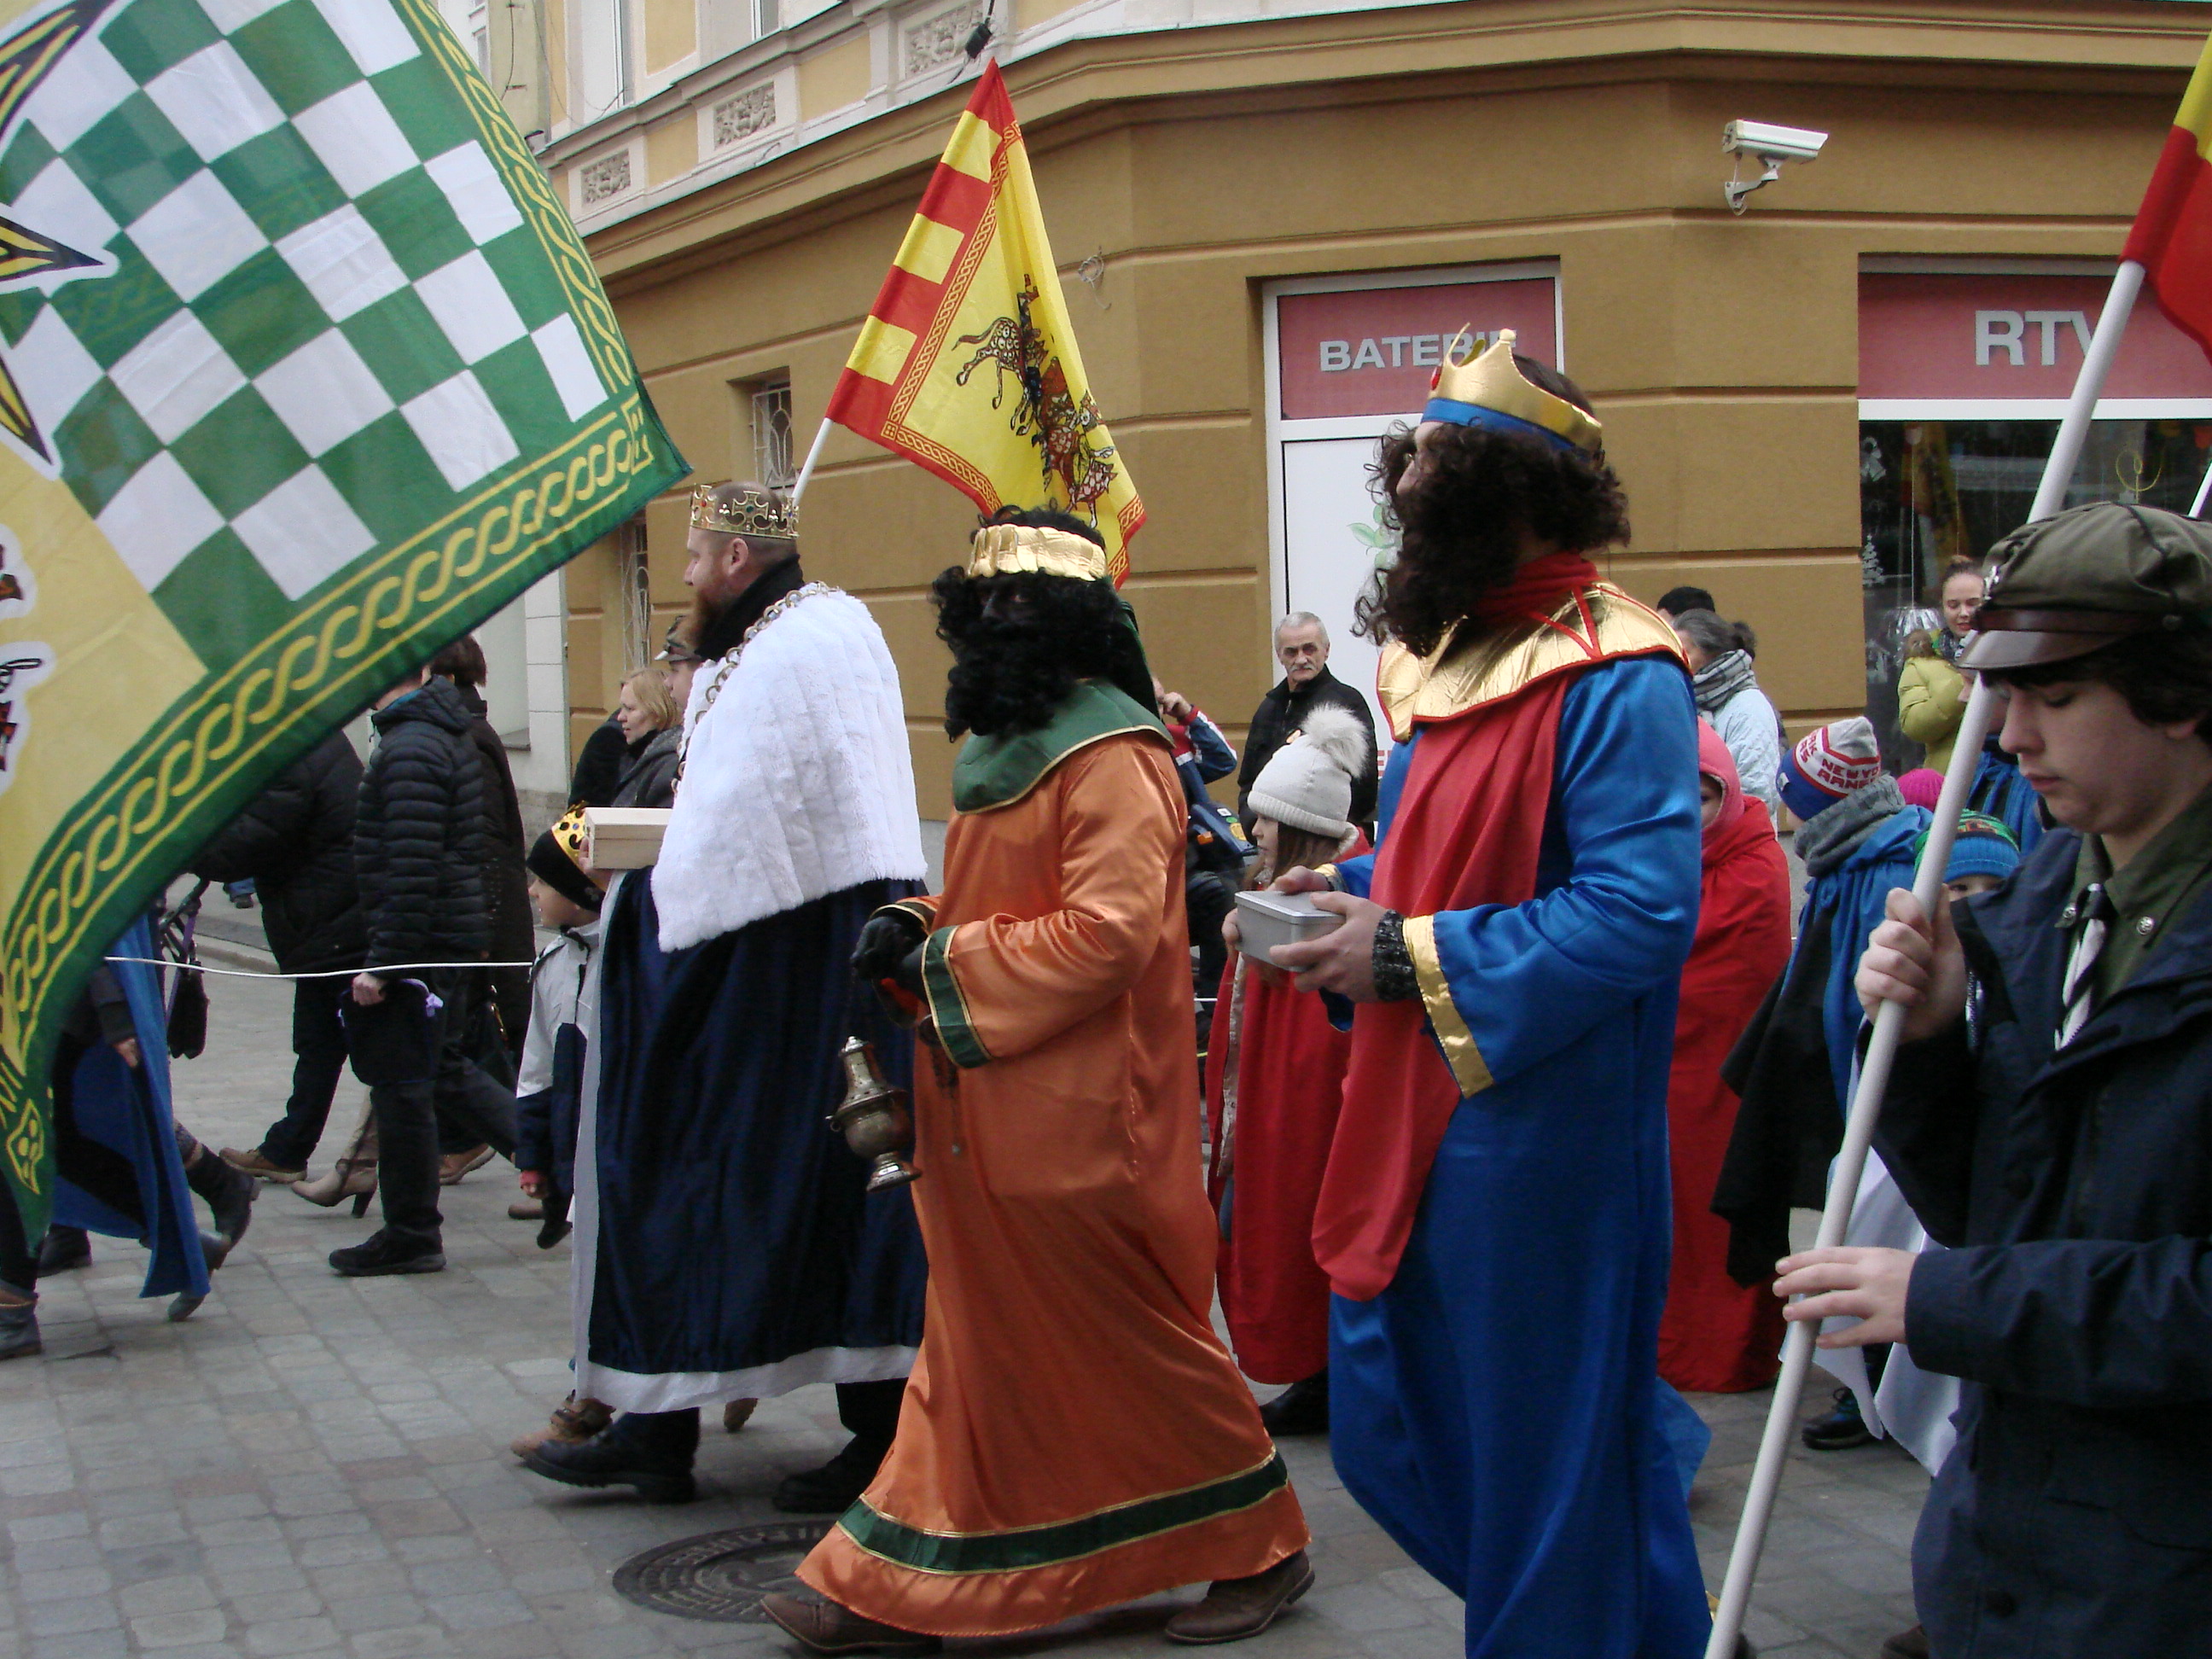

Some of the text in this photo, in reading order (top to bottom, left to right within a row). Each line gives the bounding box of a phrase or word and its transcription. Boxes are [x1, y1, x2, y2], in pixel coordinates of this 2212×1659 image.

[1817, 768, 1875, 789] RANG
[1822, 759, 1879, 780] NEW YO
